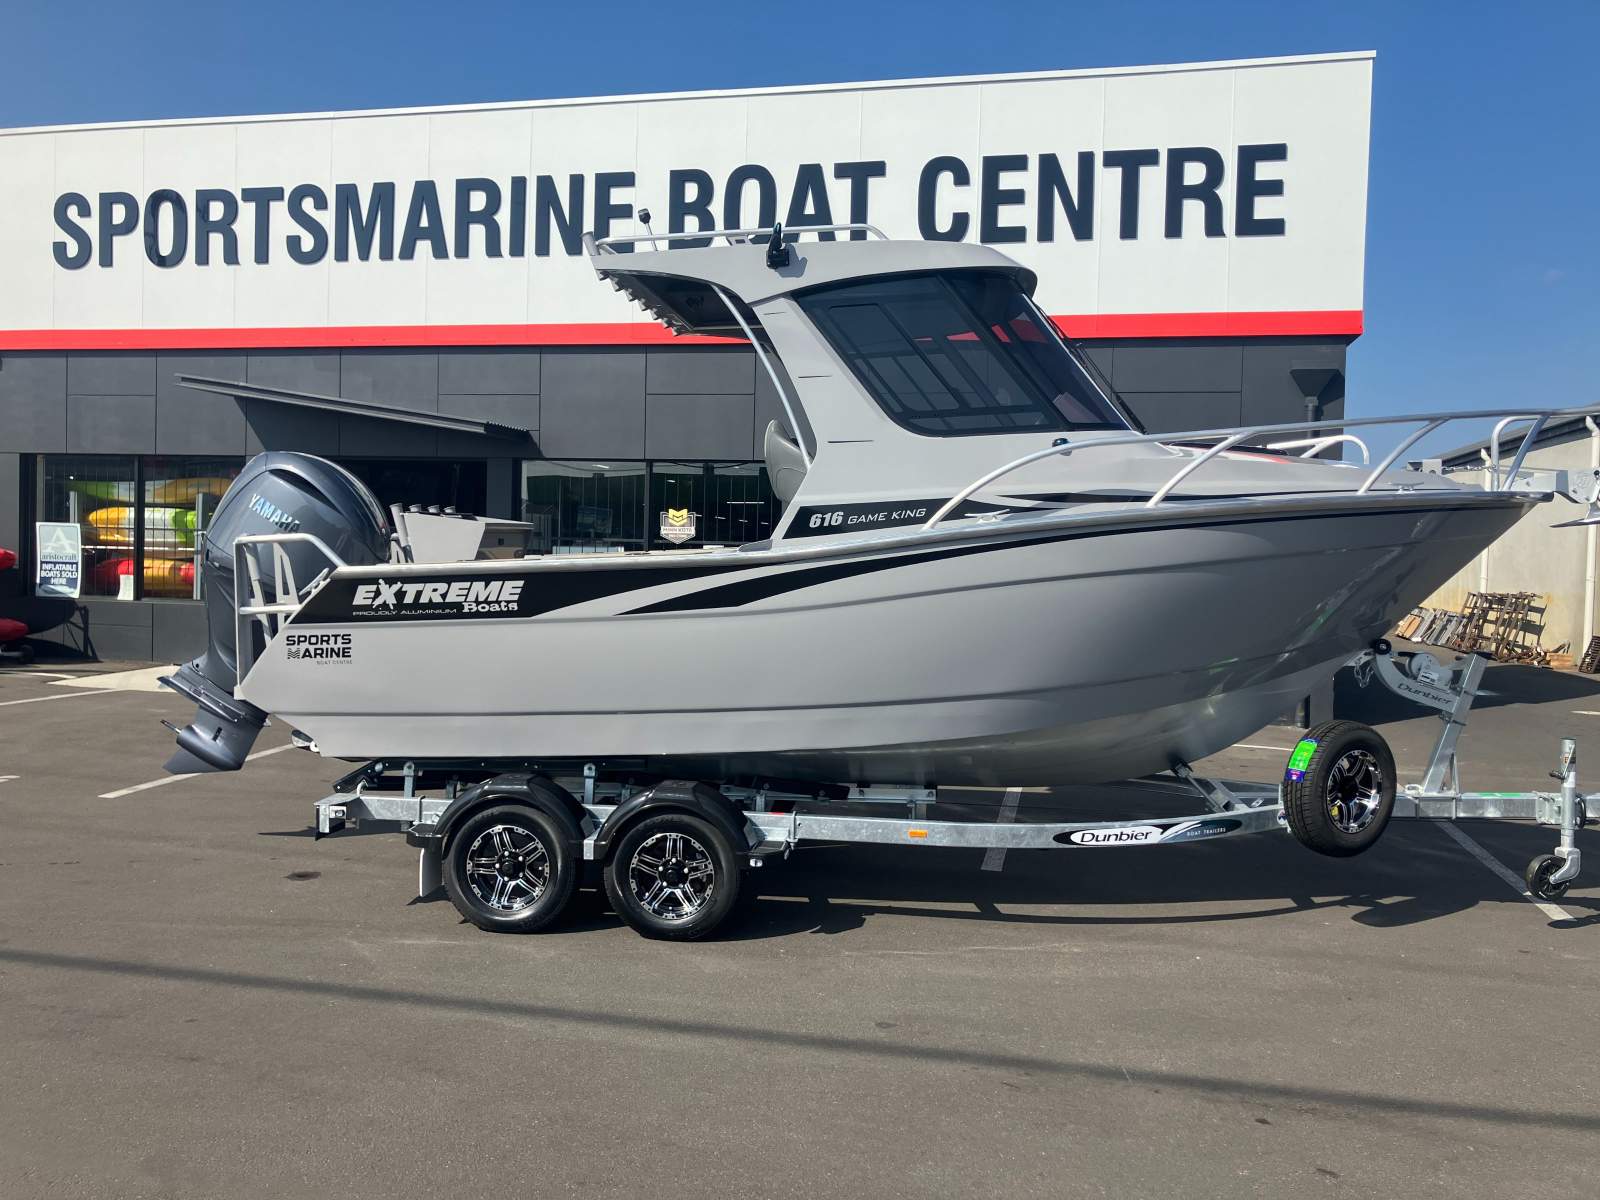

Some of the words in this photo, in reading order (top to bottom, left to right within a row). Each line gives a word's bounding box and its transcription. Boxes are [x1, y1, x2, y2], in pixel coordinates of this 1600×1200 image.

[52, 170, 636, 270] SPORTSMARINE
[667, 160, 887, 250] BOAT
[917, 142, 1289, 244] CENTRE
[248, 493, 301, 534] YAMAHA
[809, 511, 844, 528] 616
[847, 512, 888, 525] GAME
[891, 508, 927, 520] KING
[42, 563, 77, 571] INFLATABLE
[352, 578, 525, 610] EXTREME
[462, 601, 519, 613] Boats
[286, 634, 352, 646] SPORTS
[287, 647, 352, 659] MARINE
[1398, 683, 1452, 704] Dunbier
[1080, 830, 1152, 844] Dunbier
